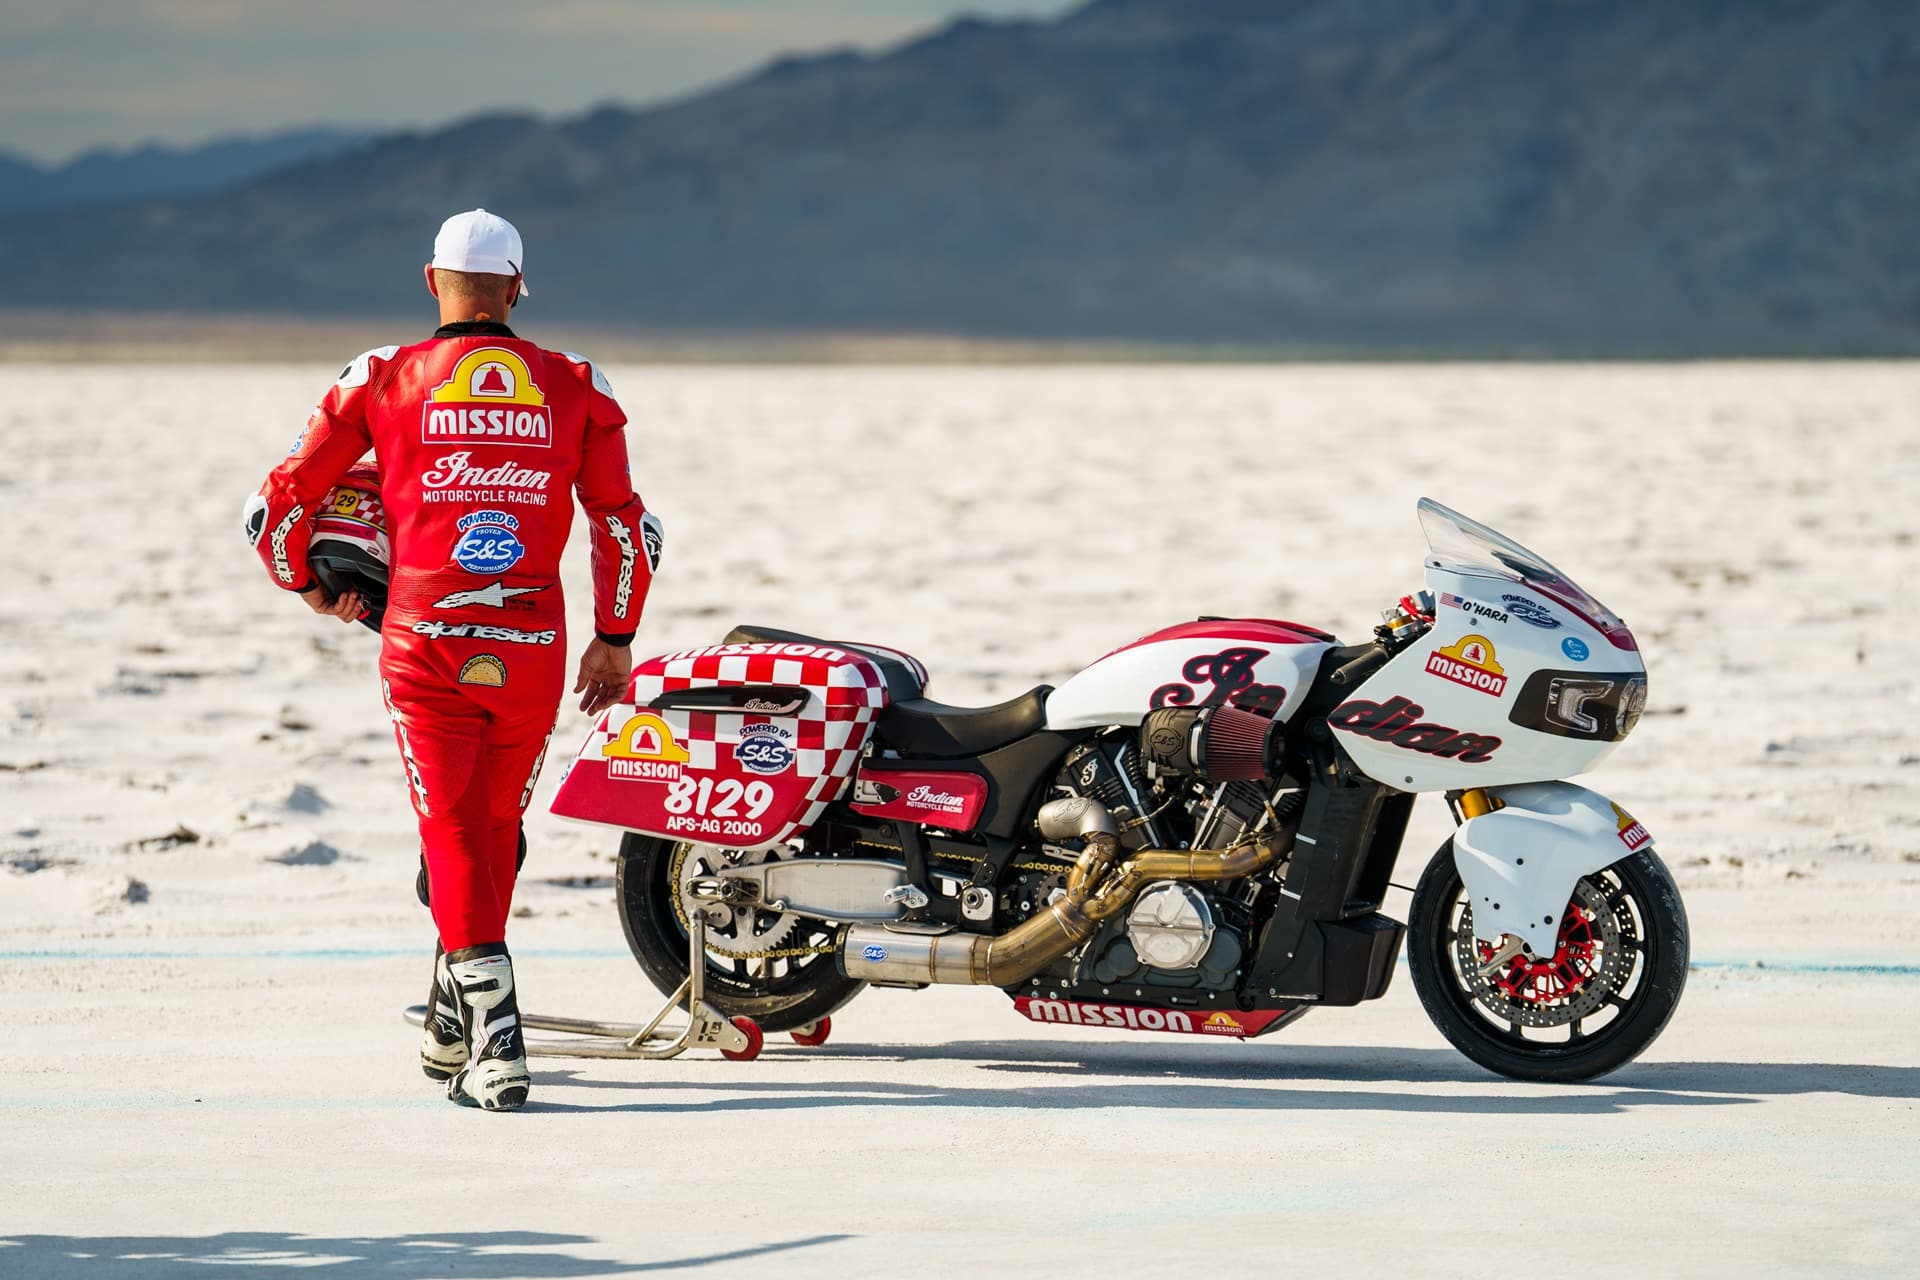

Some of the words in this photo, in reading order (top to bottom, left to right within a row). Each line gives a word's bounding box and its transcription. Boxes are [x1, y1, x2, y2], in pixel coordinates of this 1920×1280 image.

[429, 409, 546, 438] MISSION
[421, 451, 551, 489] Indian
[336, 494, 356, 507] 29
[422, 490, 505, 503] MOTORCYCLE
[508, 491, 547, 506] RACING
[458, 510, 505, 531] POWERED
[506, 515, 519, 530] BY
[475, 528, 502, 536] PROVEN
[270, 503, 305, 583] alpinestars
[459, 539, 516, 560] S&S
[466, 561, 509, 571] PERFORMANCE
[605, 515, 639, 619] alpinestars
[1502, 594, 1536, 607] POWERED
[1463, 601, 1508, 624] O'HARA
[411, 620, 557, 646] alpinestars
[1428, 656, 1503, 693] MISSION
[744, 698, 781, 711] Indian
[739, 724, 779, 736] POWERED
[779, 729, 792, 740] BY
[742, 744, 786, 763] S&S
[612, 759, 679, 779] MISSION
[664, 775, 774, 820] 8129
[907, 785, 964, 807] Indian
[906, 800, 942, 811] MOTORCYCLE
[942, 804, 963, 814] RACING
[666, 816, 720, 834] APS-AG
[723, 820, 762, 836] 2000
[864, 948, 885, 959] S&S
[1028, 999, 1194, 1032] MISSION
[1204, 1024, 1243, 1034] MISSION
